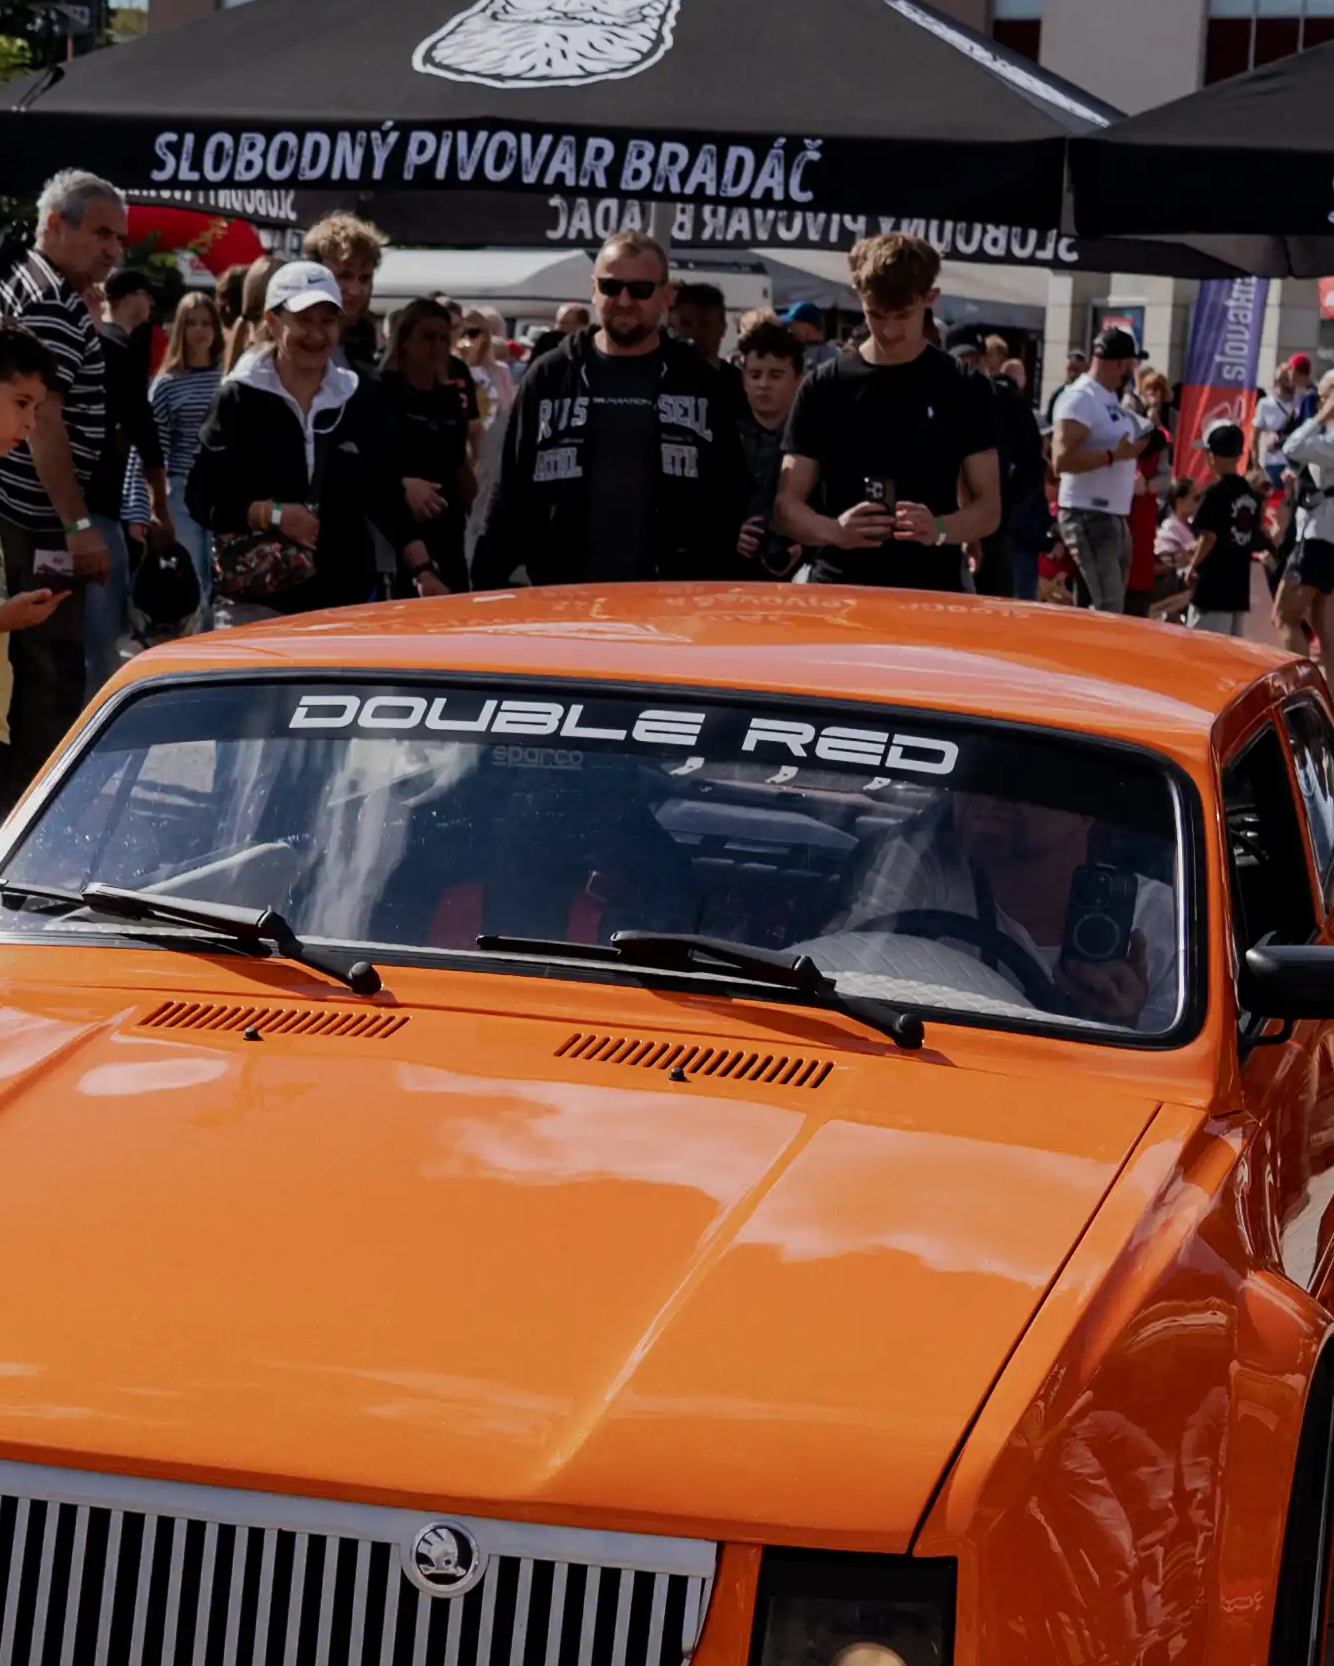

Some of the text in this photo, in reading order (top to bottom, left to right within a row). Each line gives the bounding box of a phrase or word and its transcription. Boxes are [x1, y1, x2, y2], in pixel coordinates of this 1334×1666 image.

[149, 119, 824, 203] SLOBODNÝ PIVOVAR BRADÁČ
[288, 694, 960, 776] DOUBLE RED
[491, 744, 584, 770] sparco
